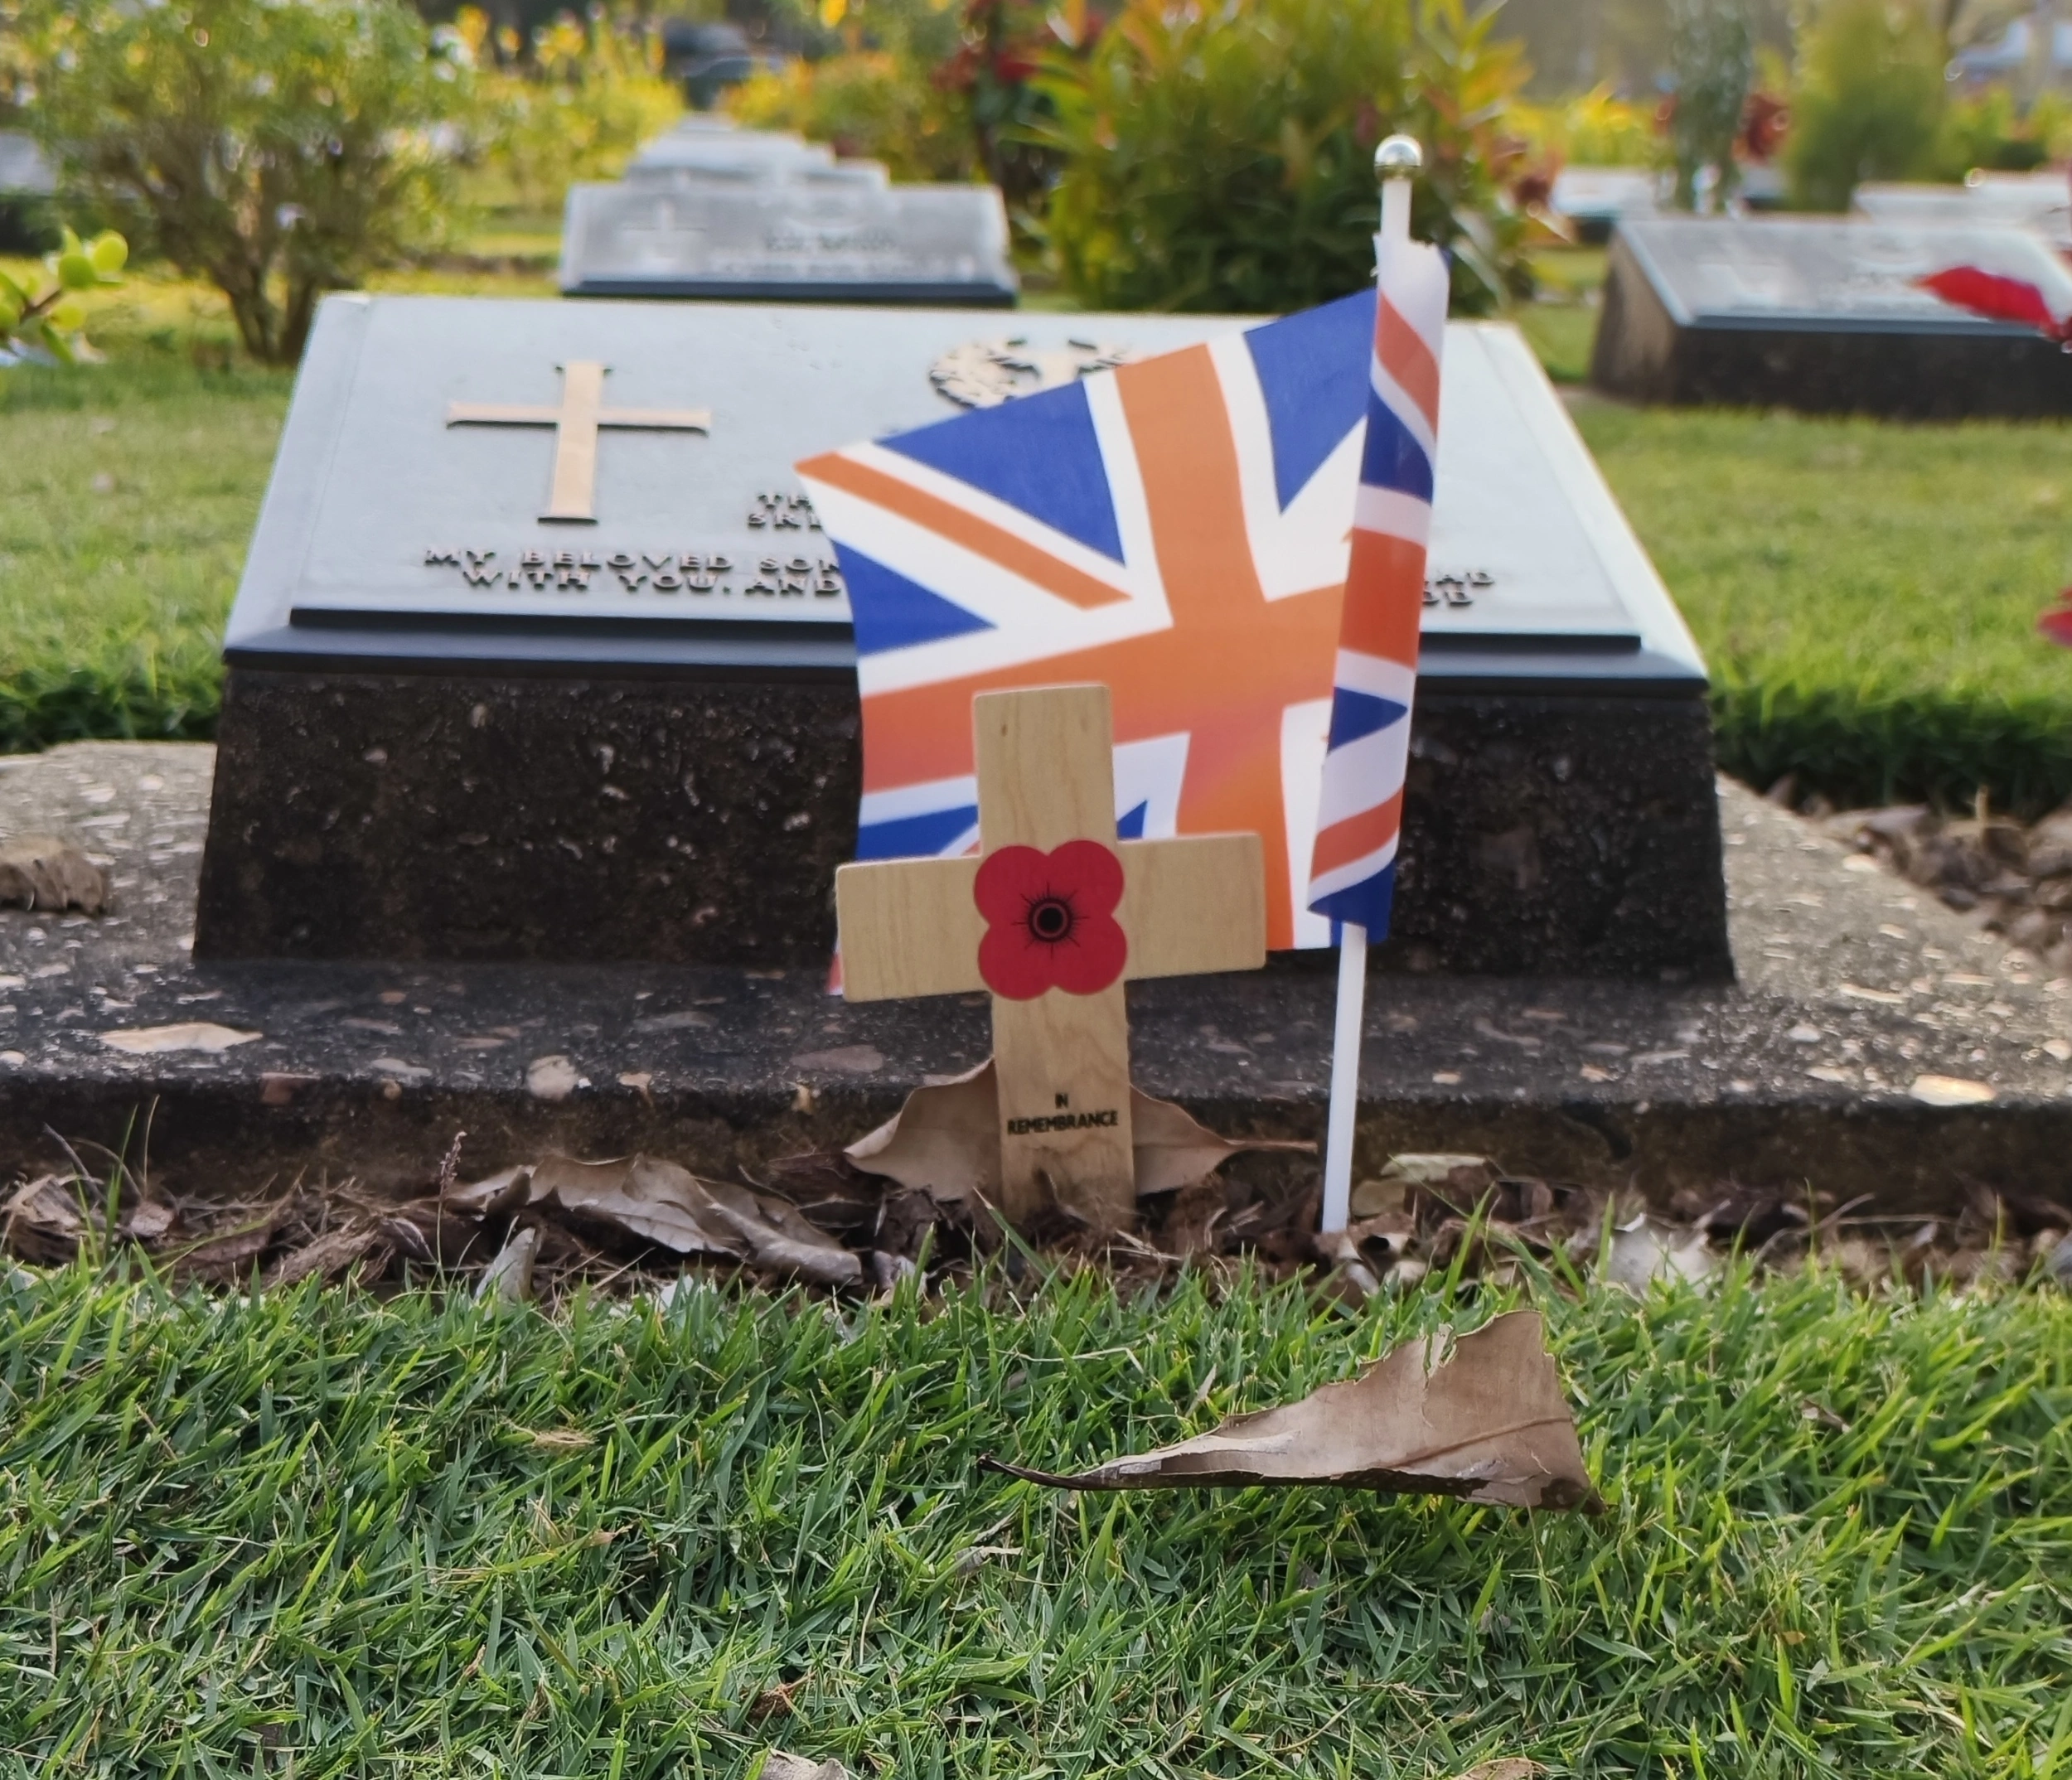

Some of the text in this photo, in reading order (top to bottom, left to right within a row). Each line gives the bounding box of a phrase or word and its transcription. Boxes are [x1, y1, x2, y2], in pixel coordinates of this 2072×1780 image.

[424, 548, 496, 568] MY
[520, 549, 734, 572] BELOVED
[462, 568, 591, 591] WITH
[744, 576, 842, 596] AND
[1055, 1093, 1069, 1110] IN
[1007, 1110, 1119, 1136] REMEMBRANCE
